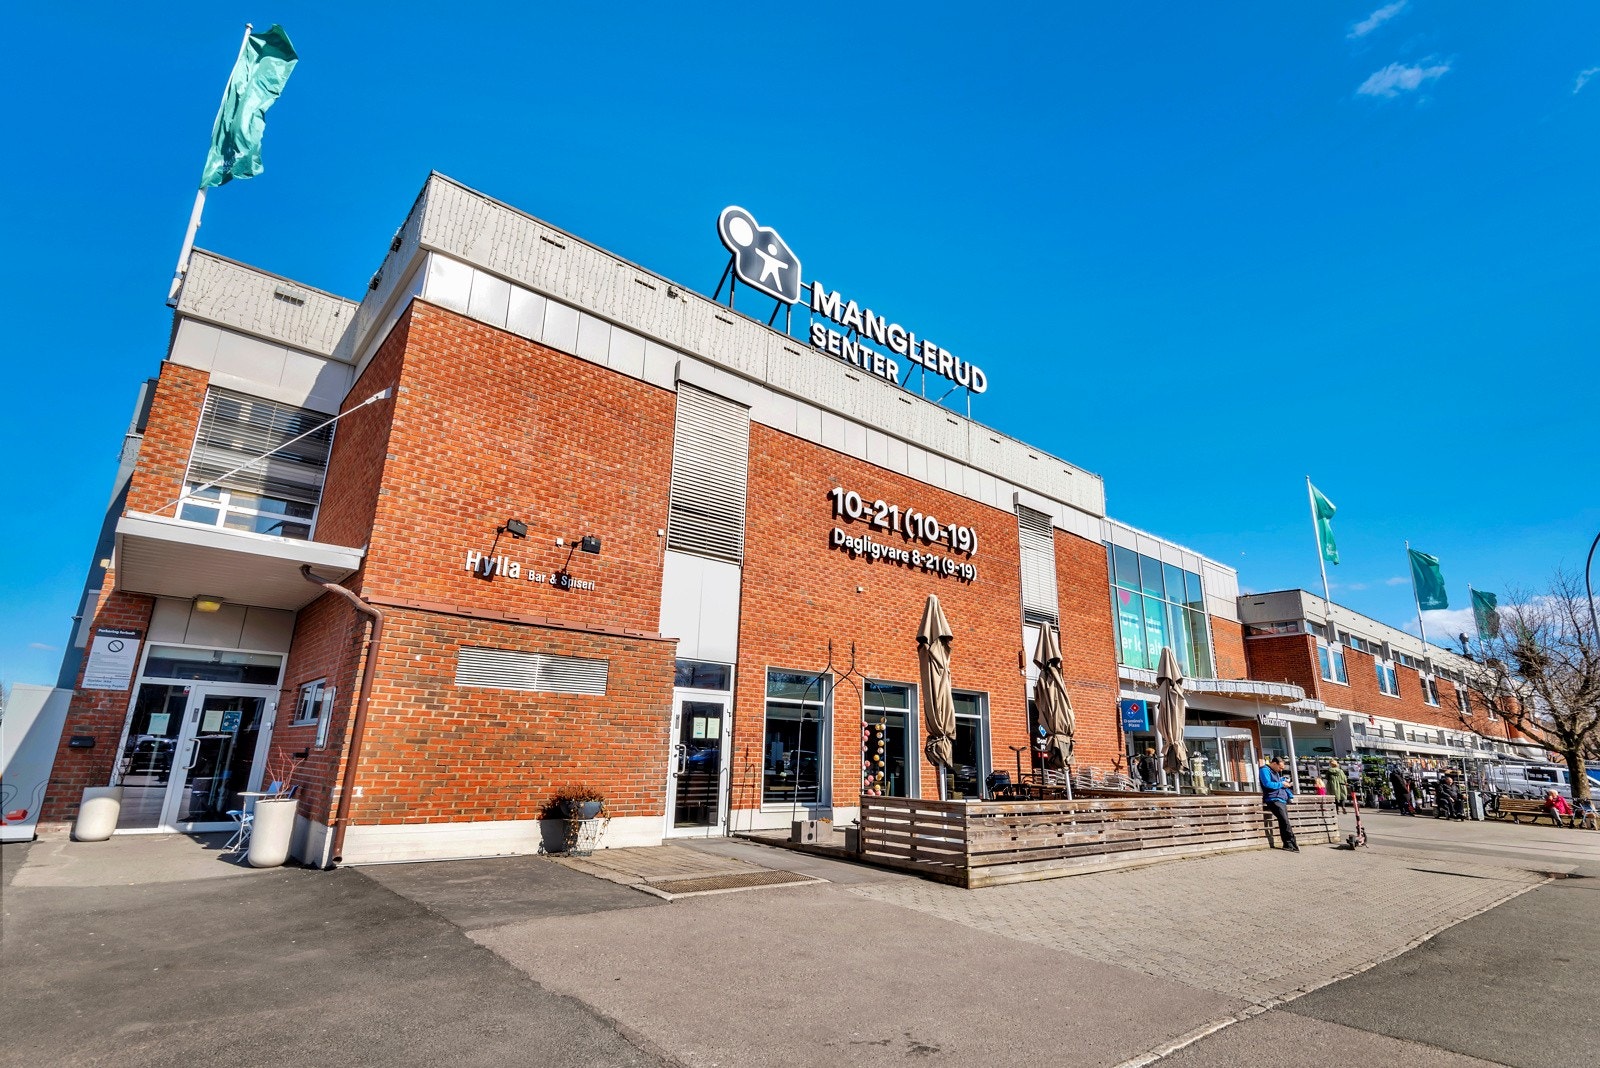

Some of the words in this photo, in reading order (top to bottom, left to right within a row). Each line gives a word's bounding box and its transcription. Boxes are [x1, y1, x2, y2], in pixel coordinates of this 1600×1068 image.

[811, 280, 988, 394] MANGLERUD
[811, 322, 899, 384] SENTER
[832, 486, 899, 531] 10-21
[904, 507, 978, 556] (10-19)
[465, 550, 521, 579] Hylla
[528, 569, 547, 583] Bar
[549, 573, 558, 585] &
[560, 575, 595, 591] Spiseri
[833, 527, 910, 564] Dagligvare
[912, 550, 940, 571] 8-21
[942, 556, 978, 581] (9-19)
